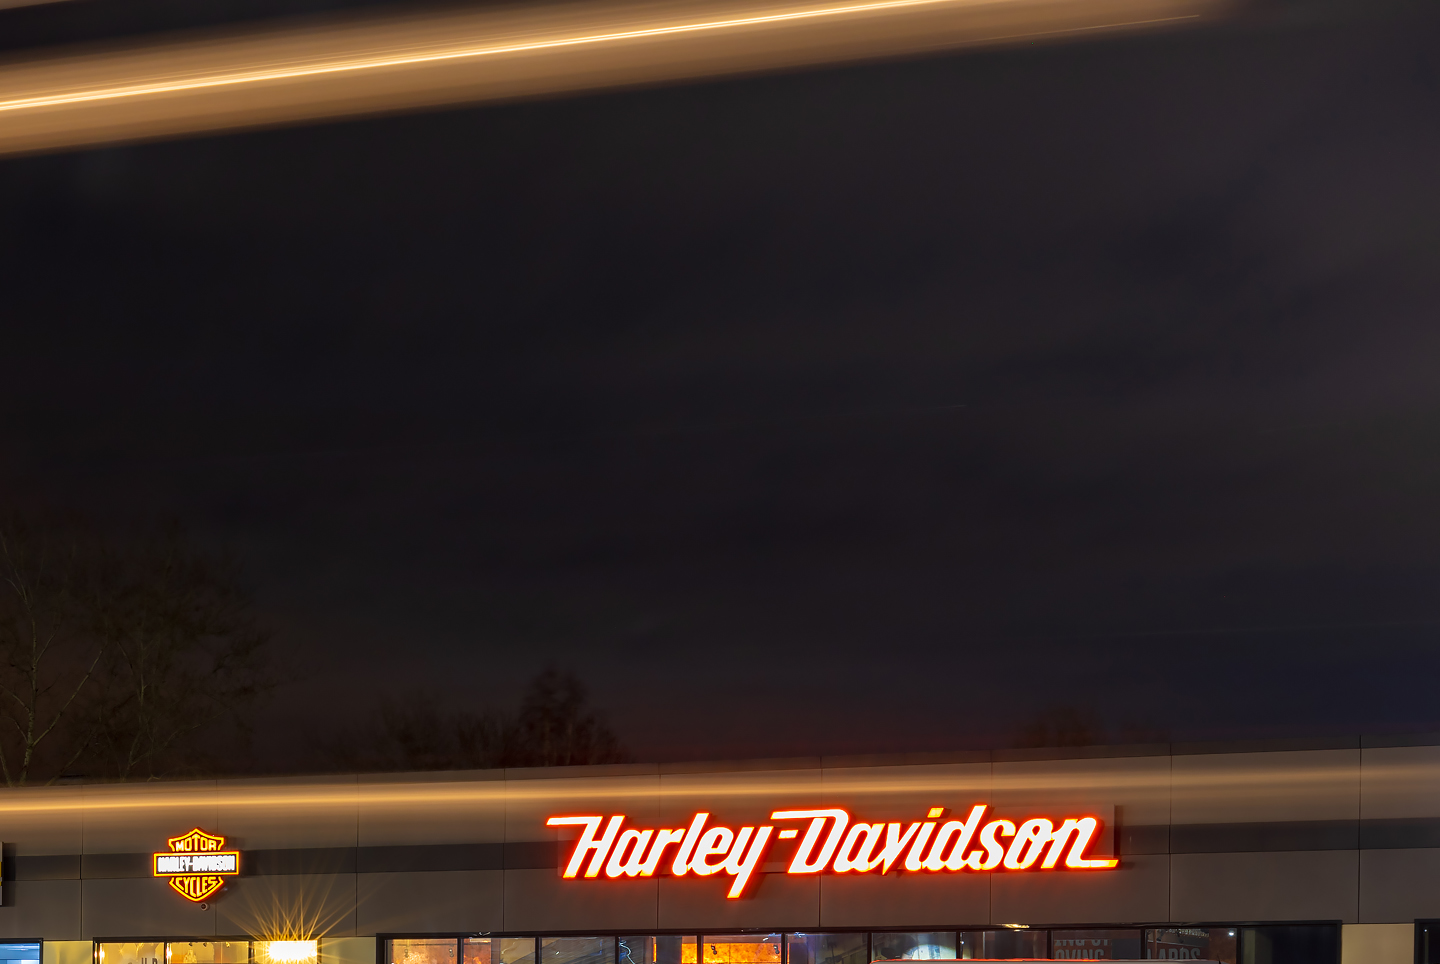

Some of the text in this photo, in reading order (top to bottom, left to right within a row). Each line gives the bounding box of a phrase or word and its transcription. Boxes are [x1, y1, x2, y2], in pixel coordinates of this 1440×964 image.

[175, 833, 217, 852] MOTOR
[547, 805, 1118, 899] Harley-Davidson
[175, 876, 218, 898] CYCLES
